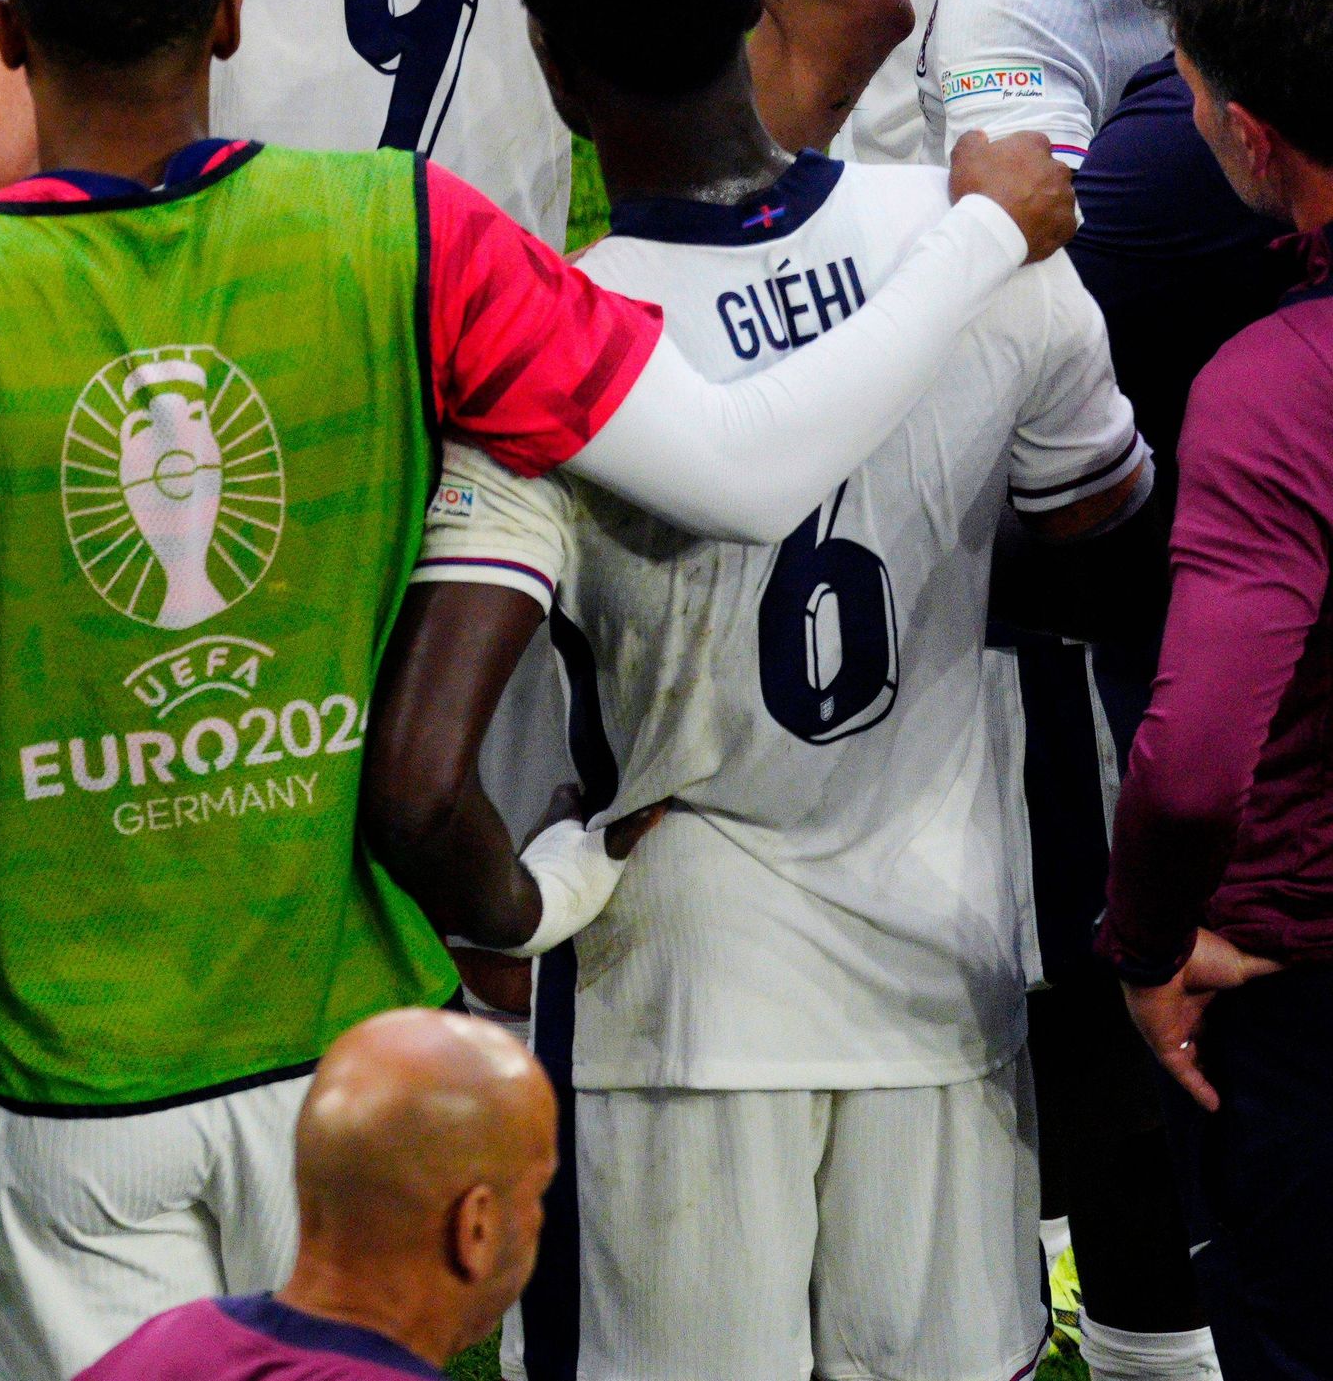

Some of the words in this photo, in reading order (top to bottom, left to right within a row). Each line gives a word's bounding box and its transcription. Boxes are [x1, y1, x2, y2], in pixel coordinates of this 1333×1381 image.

[716, 257, 866, 361] GUÉHI
[758, 477, 900, 745] 6
[133, 646, 261, 708] UEFA
[112, 771, 319, 836] GERMANY
